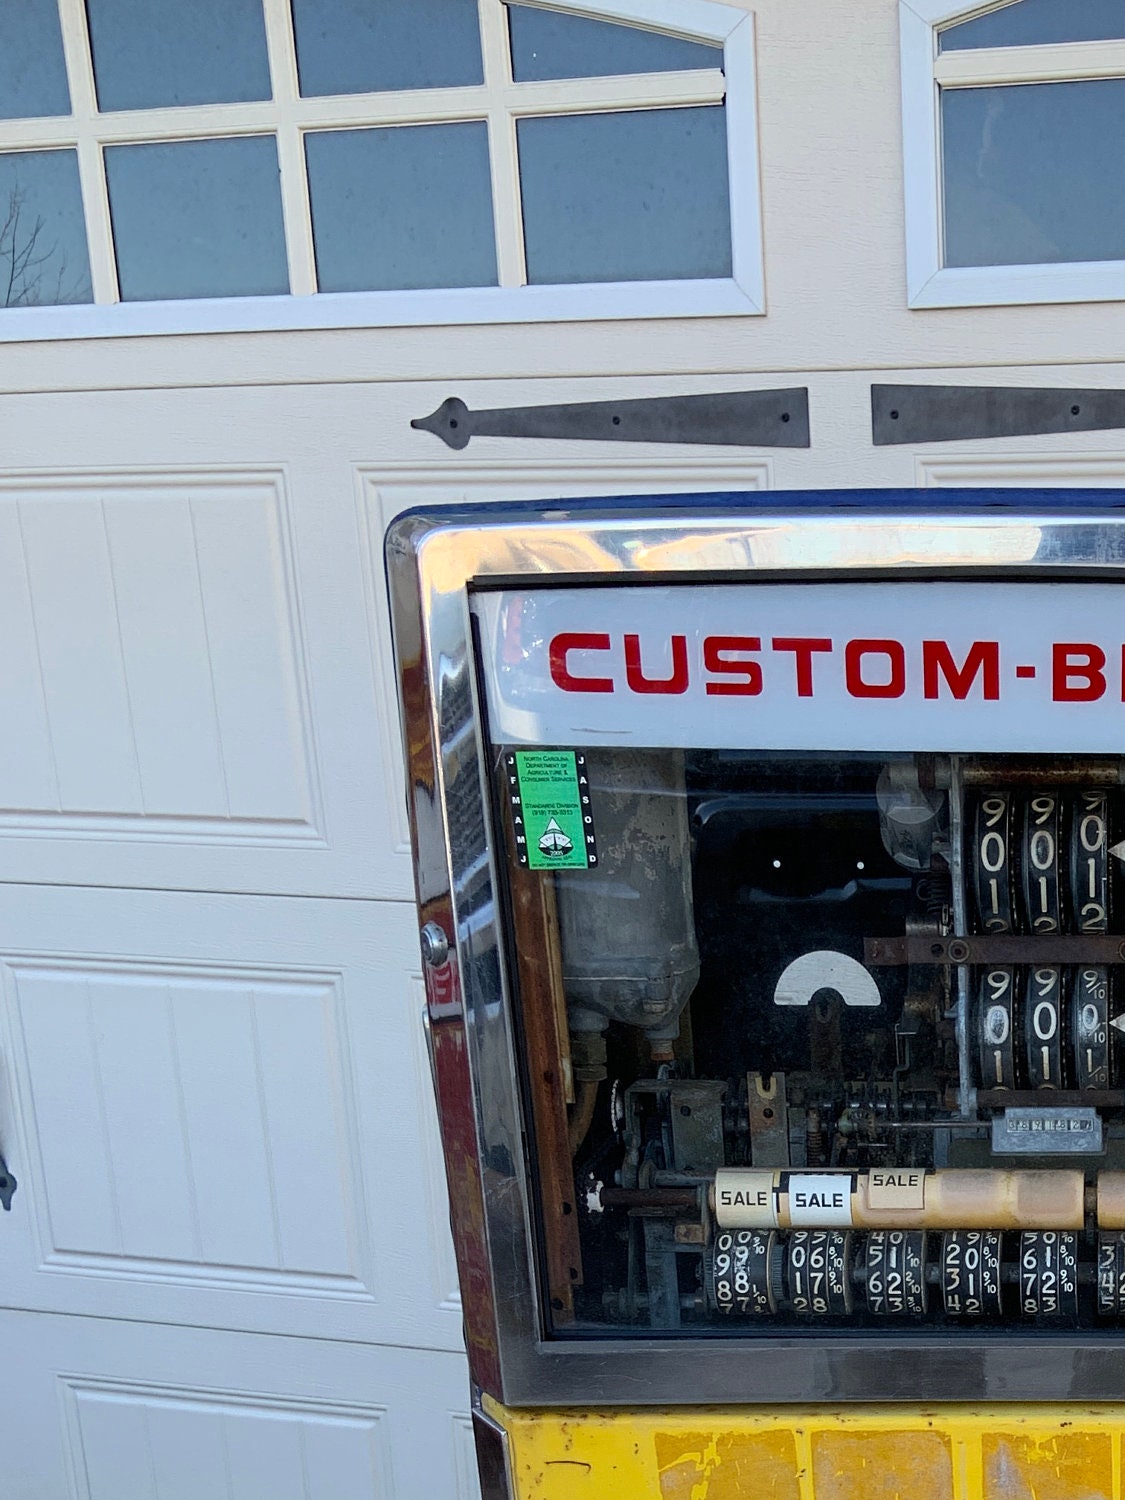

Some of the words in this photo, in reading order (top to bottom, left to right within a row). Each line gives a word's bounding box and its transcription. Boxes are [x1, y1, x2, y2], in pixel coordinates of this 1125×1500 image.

[873, 1174, 918, 1187] SALE
[721, 1191, 767, 1206] SALE
[795, 1192, 843, 1208] SALE
